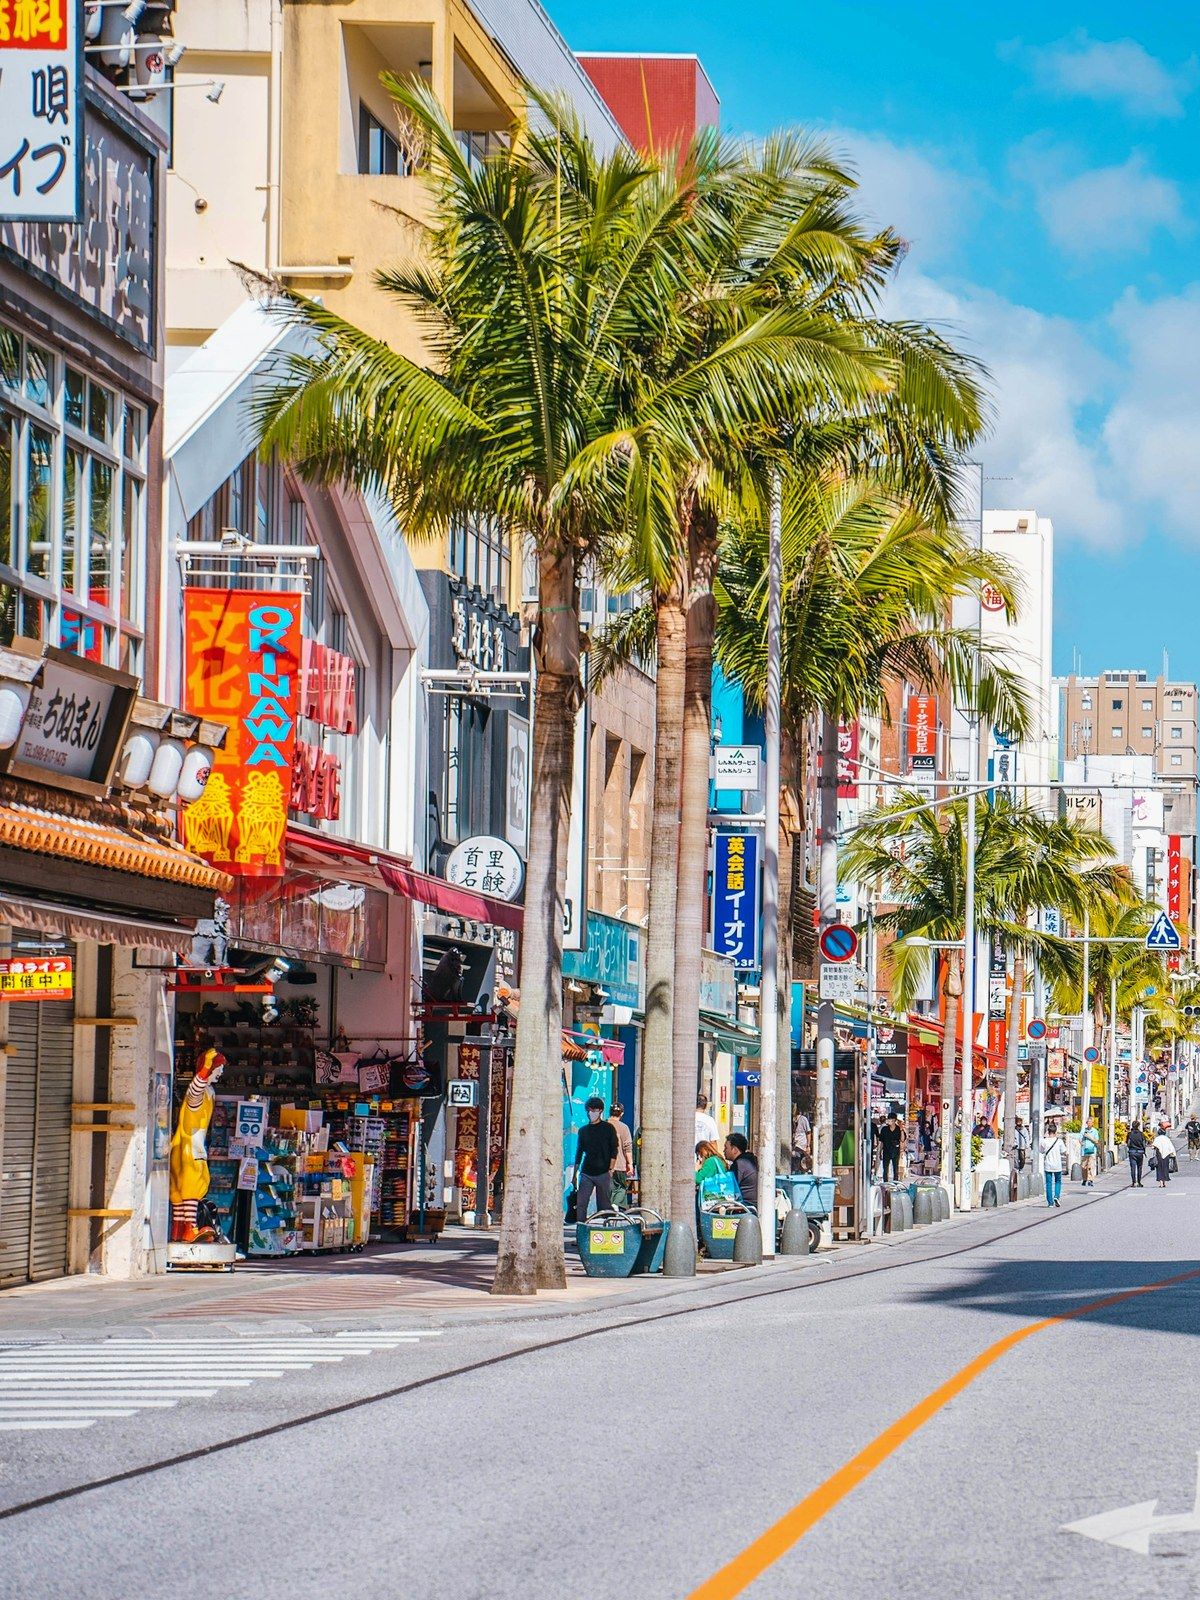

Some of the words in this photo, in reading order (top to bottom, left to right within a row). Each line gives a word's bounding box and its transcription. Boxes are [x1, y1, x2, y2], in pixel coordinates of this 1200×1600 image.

[244, 606, 295, 767] OKINAWA
[42, 688, 102, 751] ちぬまん
[464, 846, 504, 869] 首里
[727, 837, 745, 890] 英会話
[724, 890, 746, 957] イーオン
